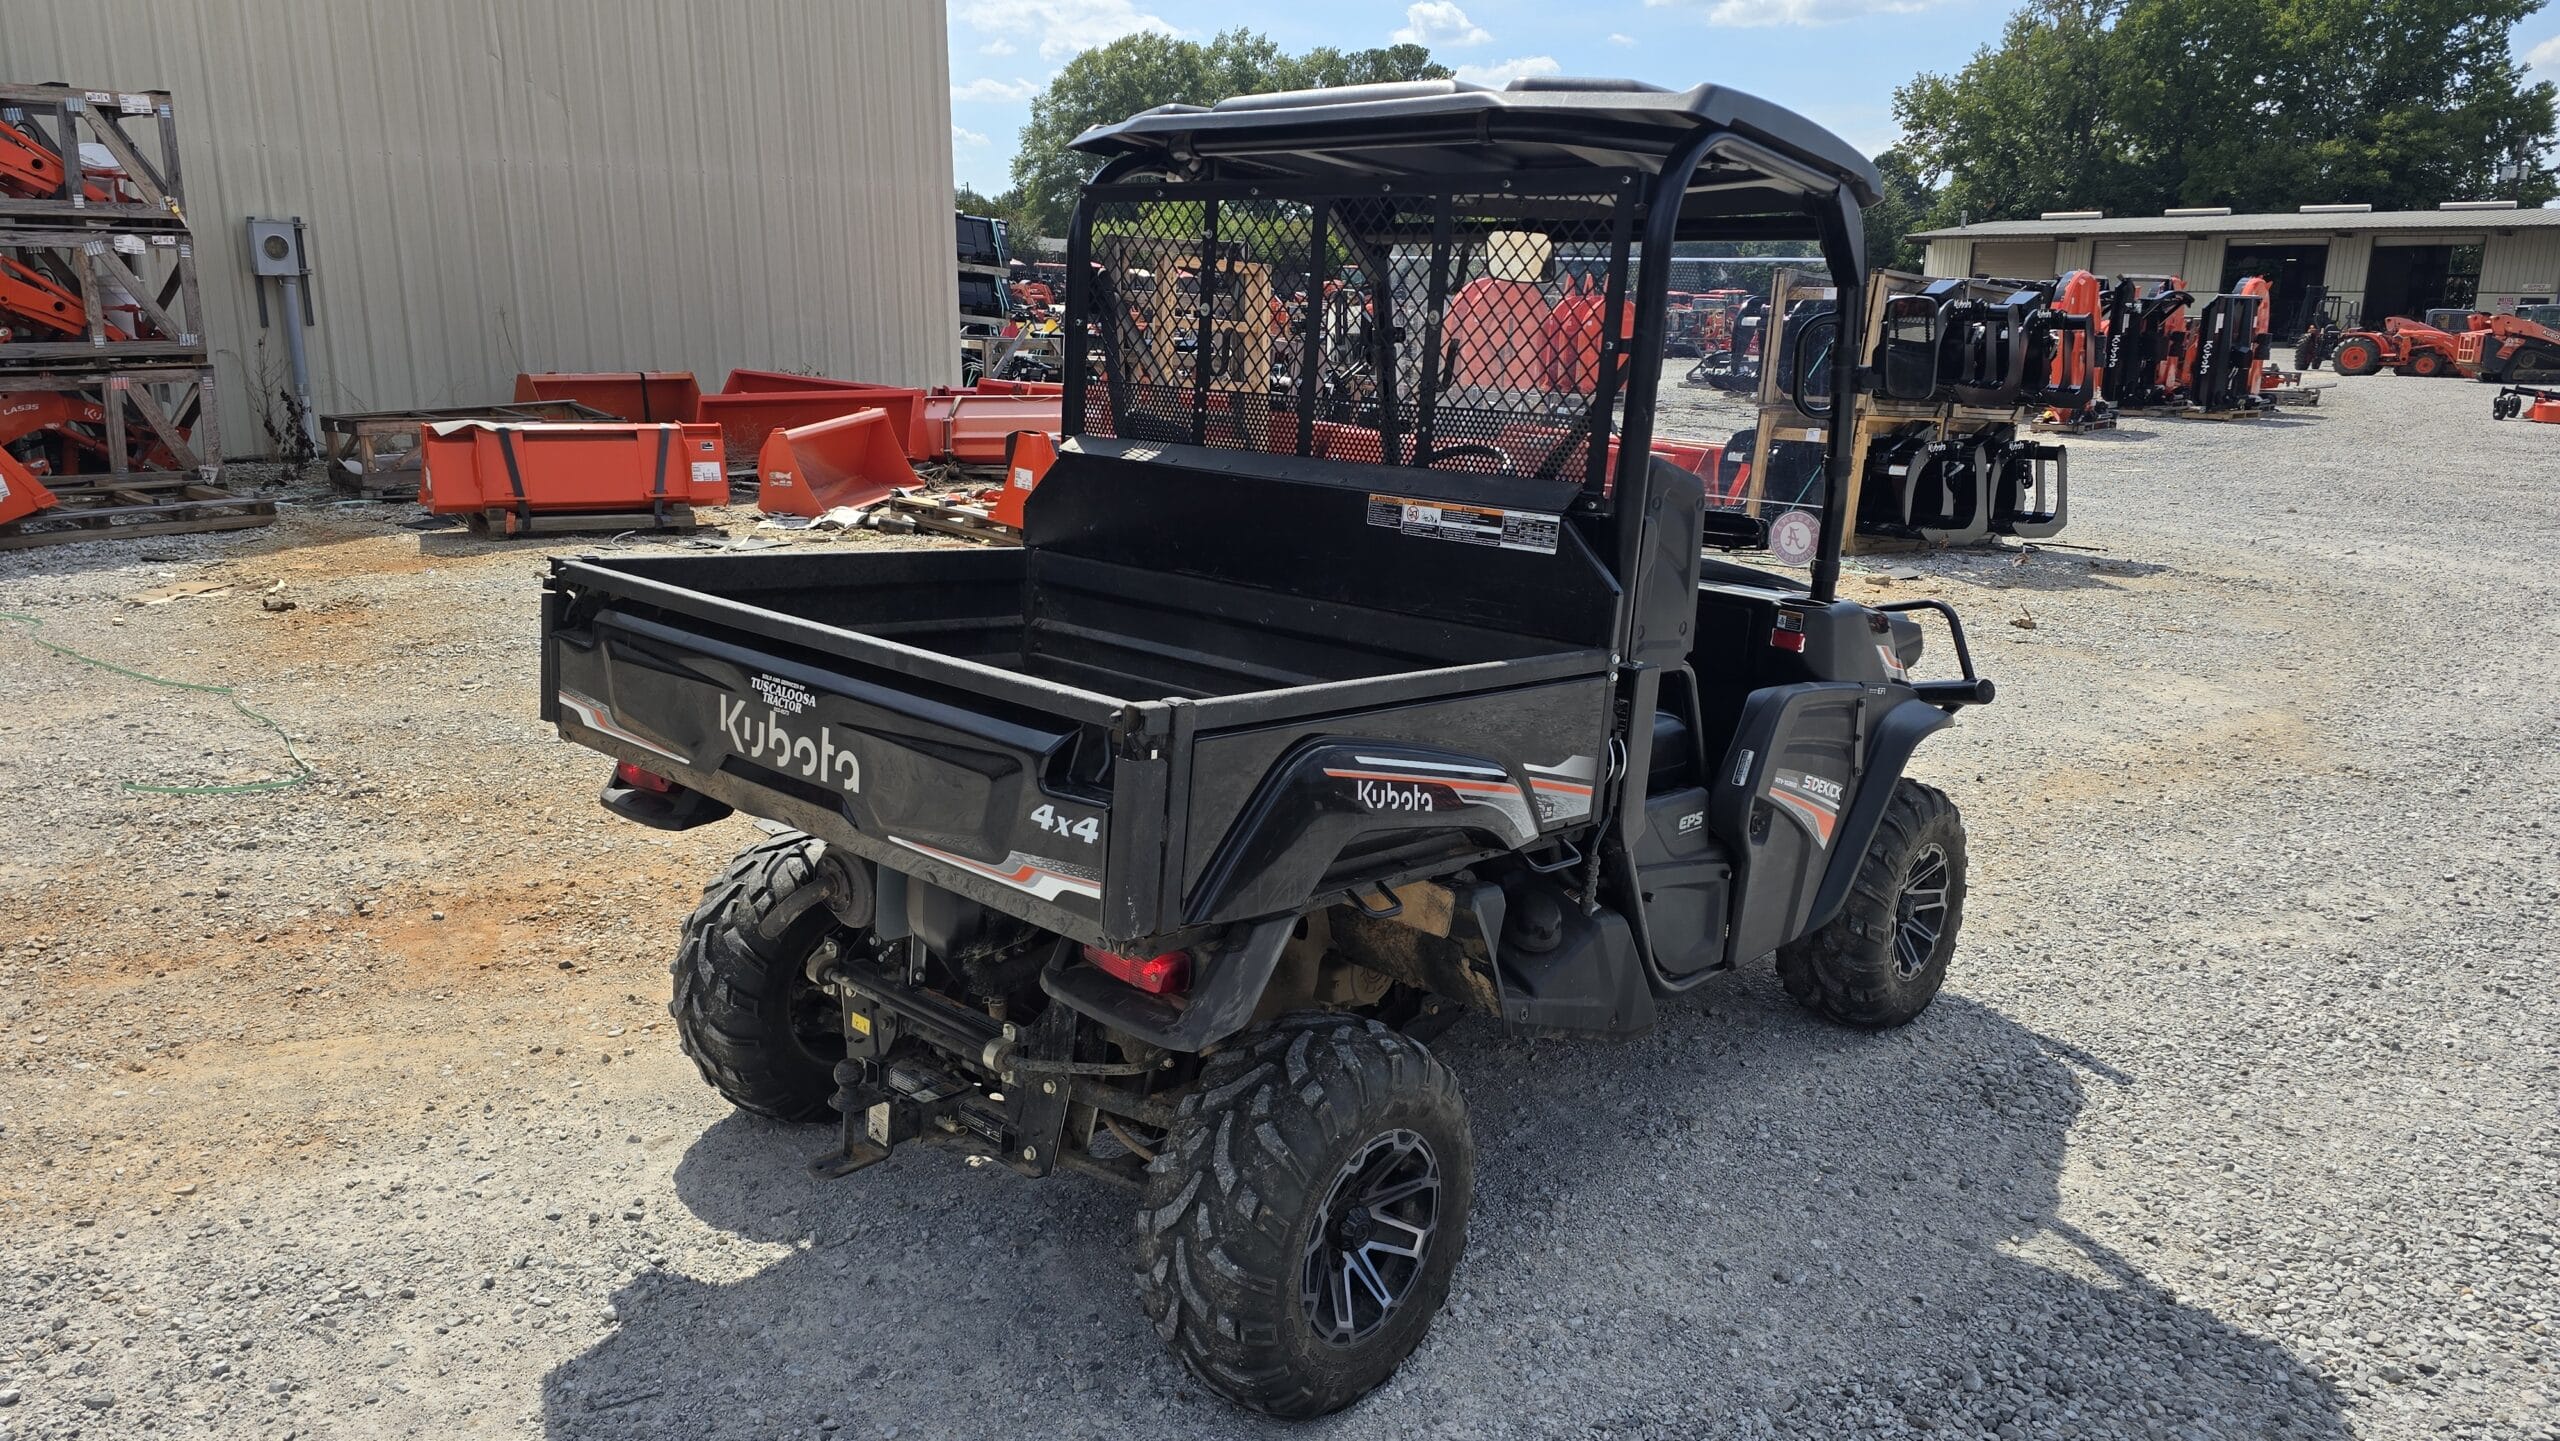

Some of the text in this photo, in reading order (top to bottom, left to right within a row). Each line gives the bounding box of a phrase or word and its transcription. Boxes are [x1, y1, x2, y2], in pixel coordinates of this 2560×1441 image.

[2108, 334, 2121, 368] Kubota
[2542, 330, 2560, 340] KUBO
[2199, 340, 2214, 375] Kubota
[751, 676, 817, 708] TUSCALOOSA
[762, 692, 803, 714] TRACTOR
[720, 693, 861, 794] Kubota
[1357, 780, 1433, 813] Kubota
[1802, 774, 1844, 801] SIDEKICK
[1030, 803, 1099, 845] 4x4
[1679, 811, 1704, 830] EPS
